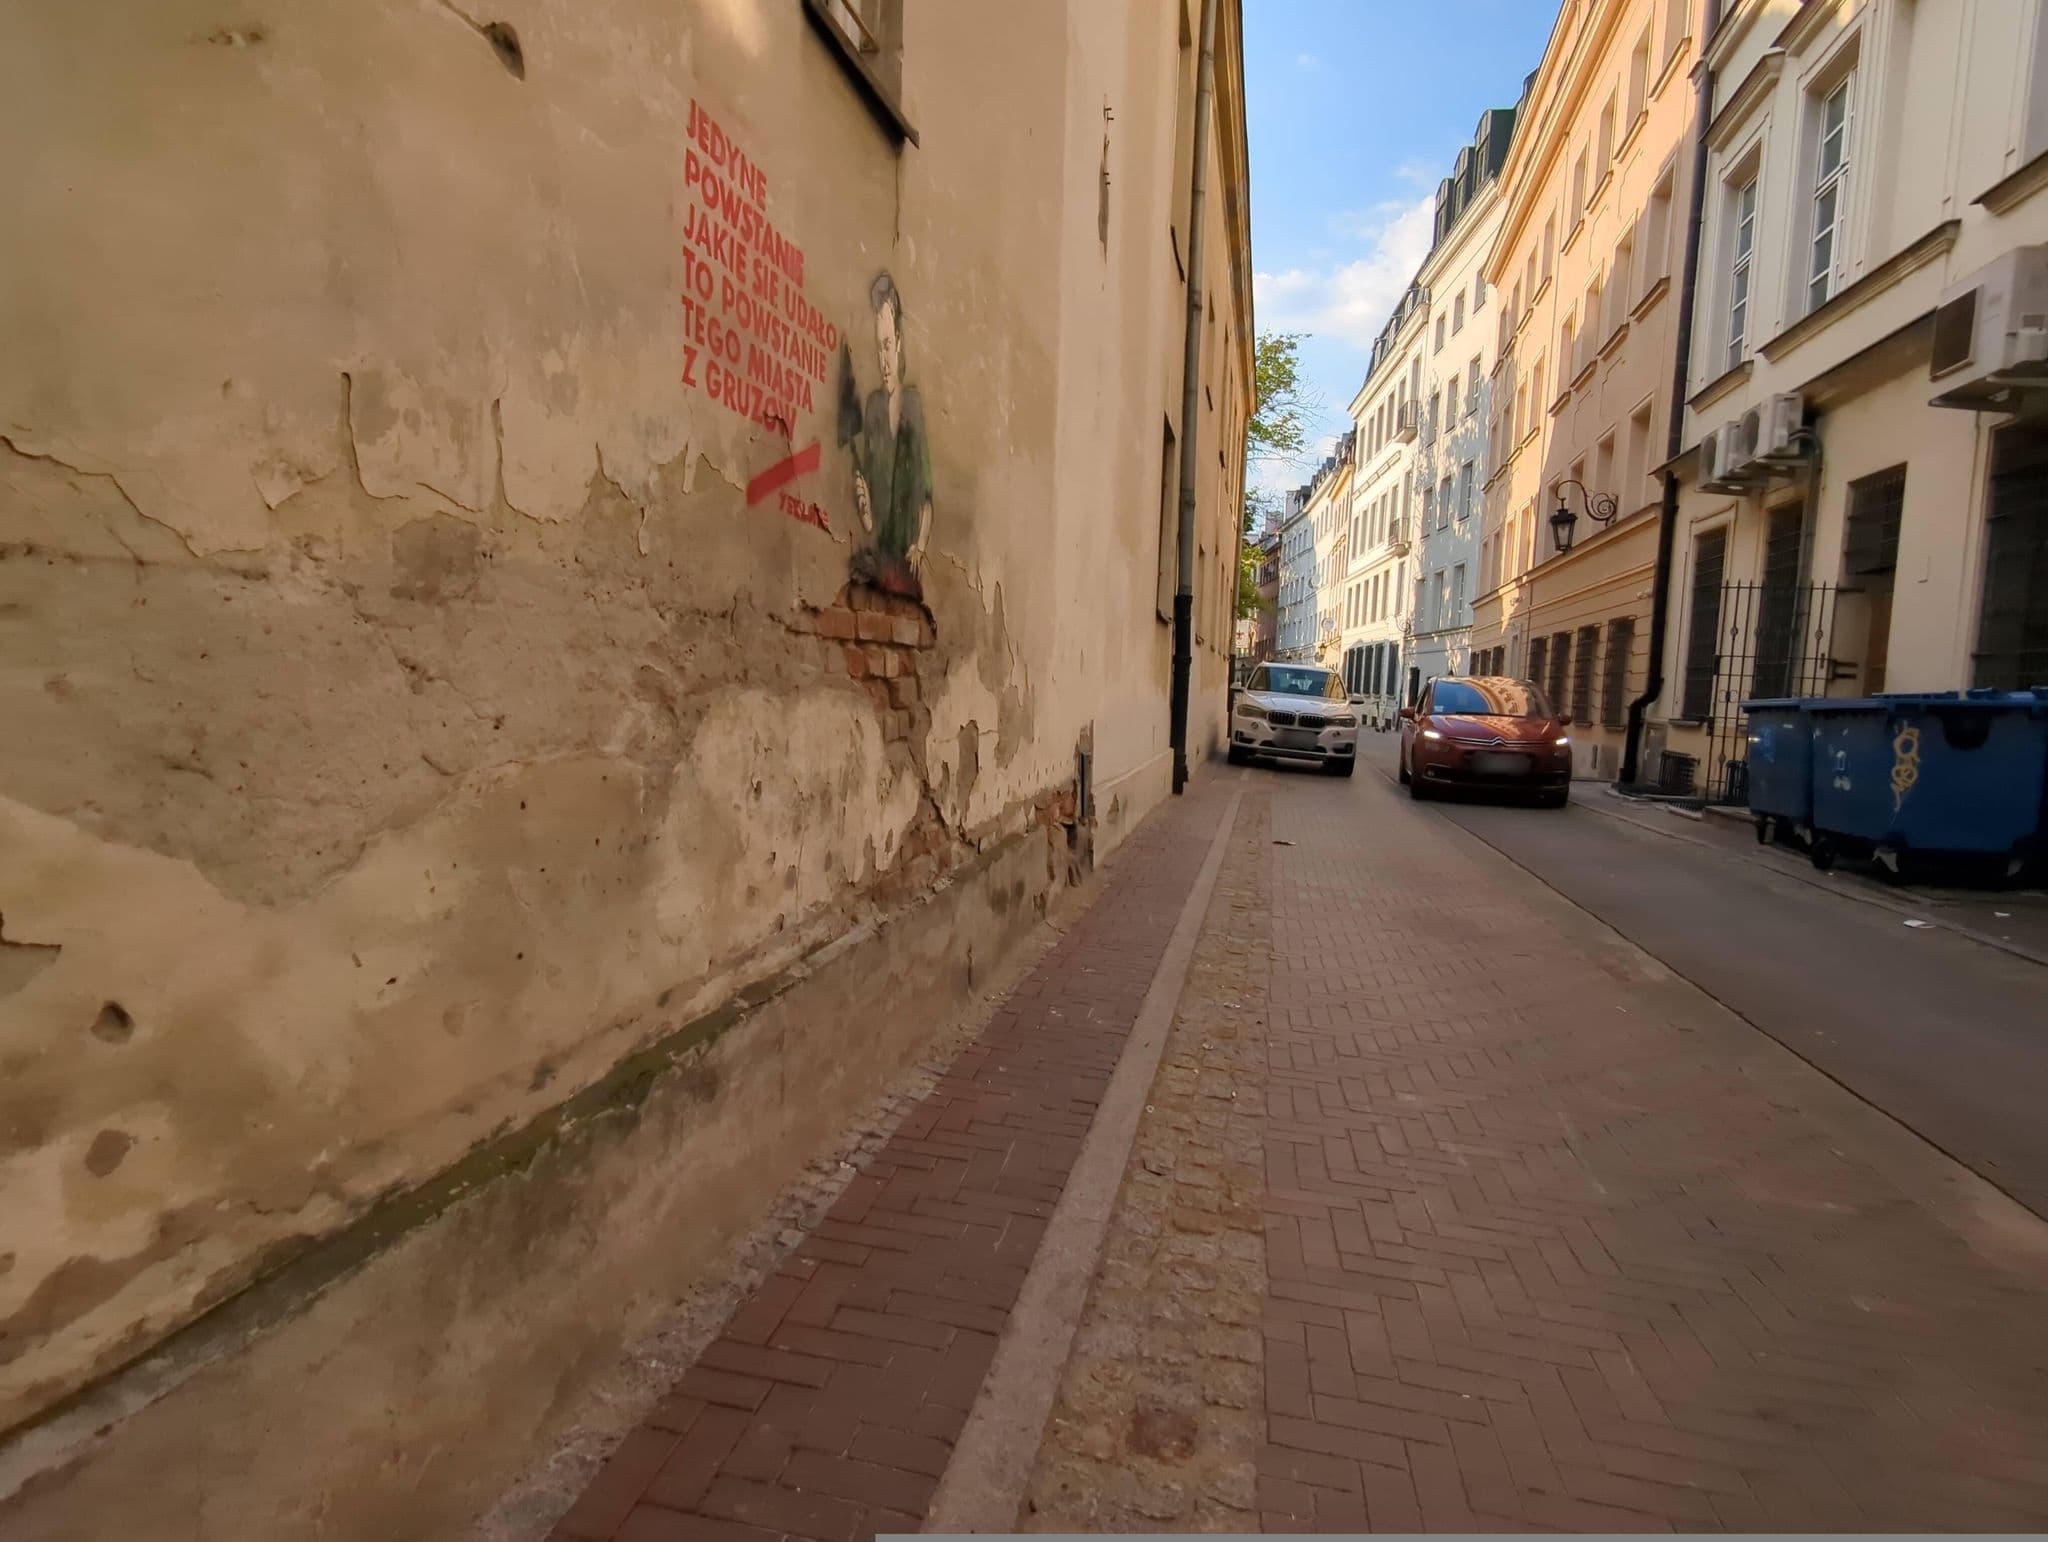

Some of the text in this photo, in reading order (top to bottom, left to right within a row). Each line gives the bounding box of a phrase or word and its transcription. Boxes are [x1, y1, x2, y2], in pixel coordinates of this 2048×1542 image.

[684, 147, 805, 289] POWSTANIE
[686, 98, 767, 212] JEDYNE
[682, 245, 827, 384] TO POWSTANIE
[683, 202, 747, 284] JAKIE
[784, 283, 837, 352] UDAŁO
[681, 294, 813, 414] TEGO MIASTA
[681, 344, 698, 388] Z
